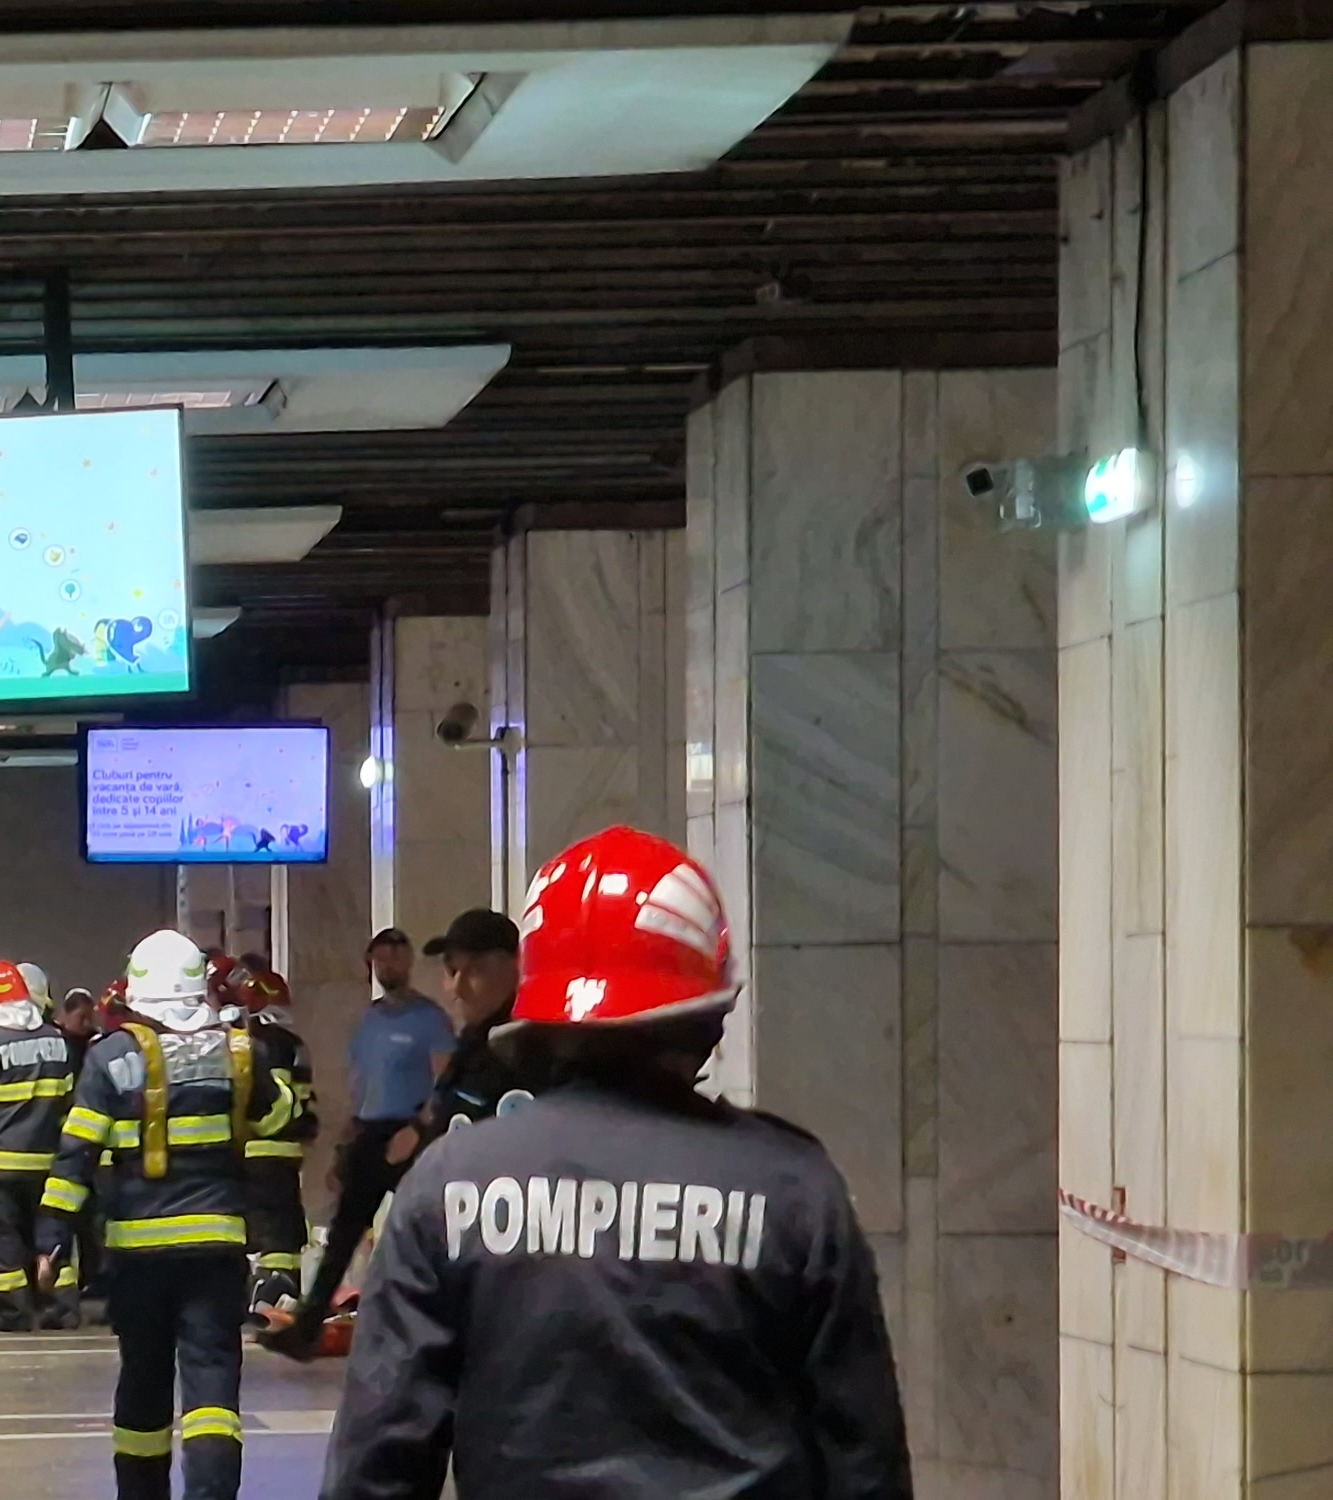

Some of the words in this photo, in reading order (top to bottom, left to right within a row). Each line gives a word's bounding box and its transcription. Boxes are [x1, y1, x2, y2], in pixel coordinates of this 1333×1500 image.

[92, 769, 133, 780] Cluburi
[135, 770, 173, 782] pentru
[443, 1176, 766, 1269] POMPIERII
